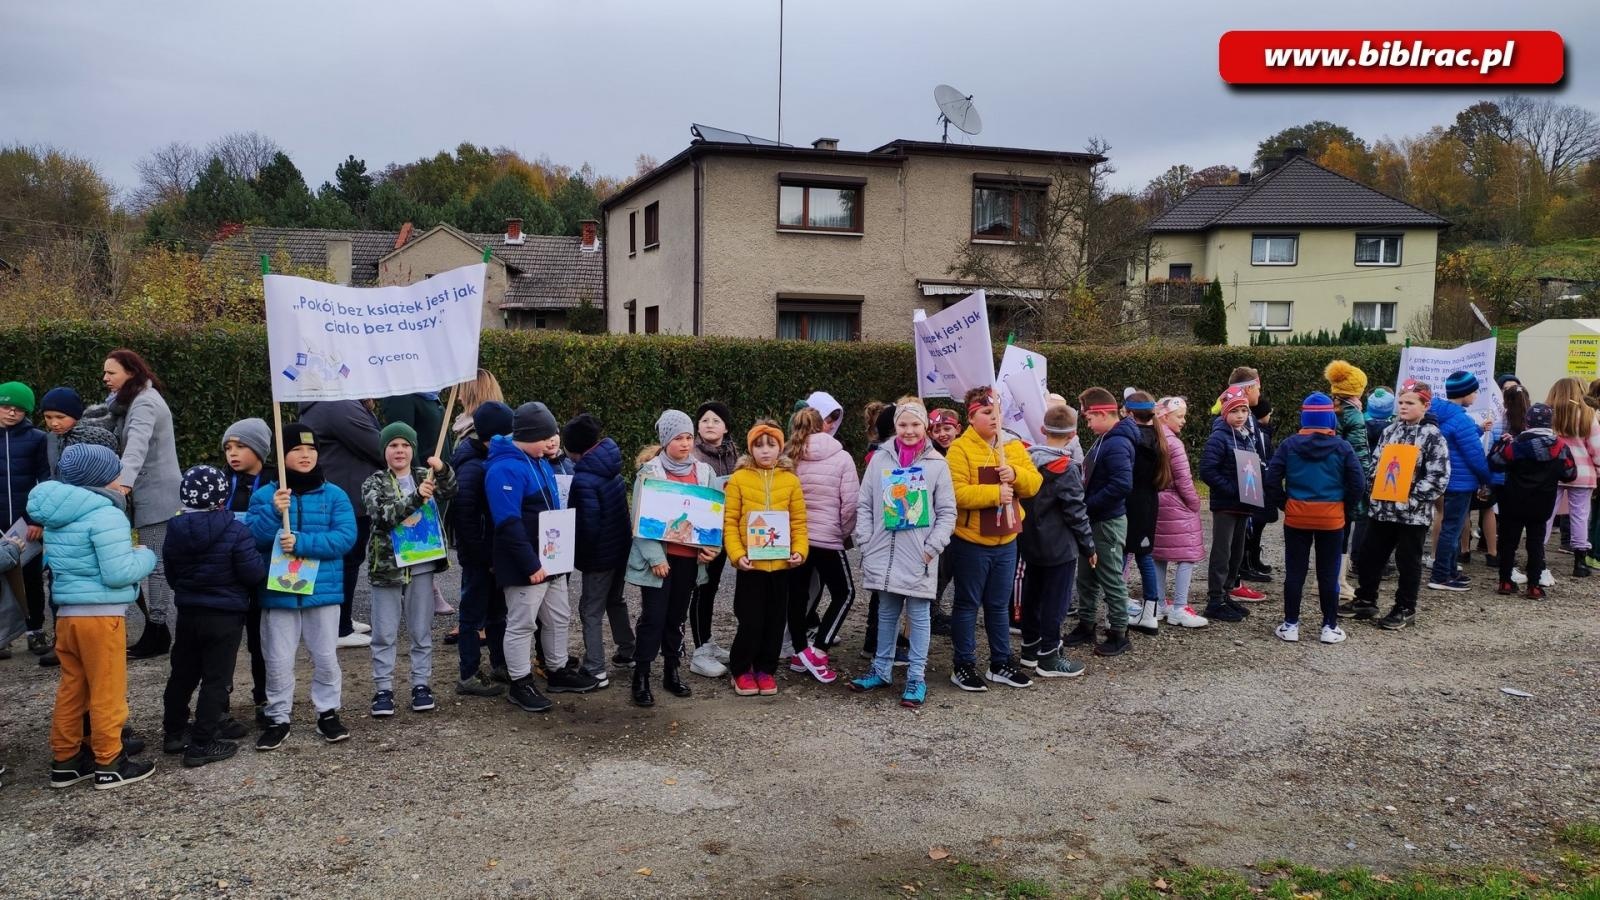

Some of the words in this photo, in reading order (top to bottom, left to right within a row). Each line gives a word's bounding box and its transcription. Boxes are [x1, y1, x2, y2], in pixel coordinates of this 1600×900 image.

[338, 303, 363, 317] bez
[367, 302, 423, 316] książek
[424, 289, 450, 310] jest
[452, 283, 477, 303] jak
[325, 320, 360, 335] ciało
[364, 320, 393, 335] bez
[942, 320, 963, 339] jest
[962, 311, 982, 328] jak
[368, 352, 419, 366] Cyceron
